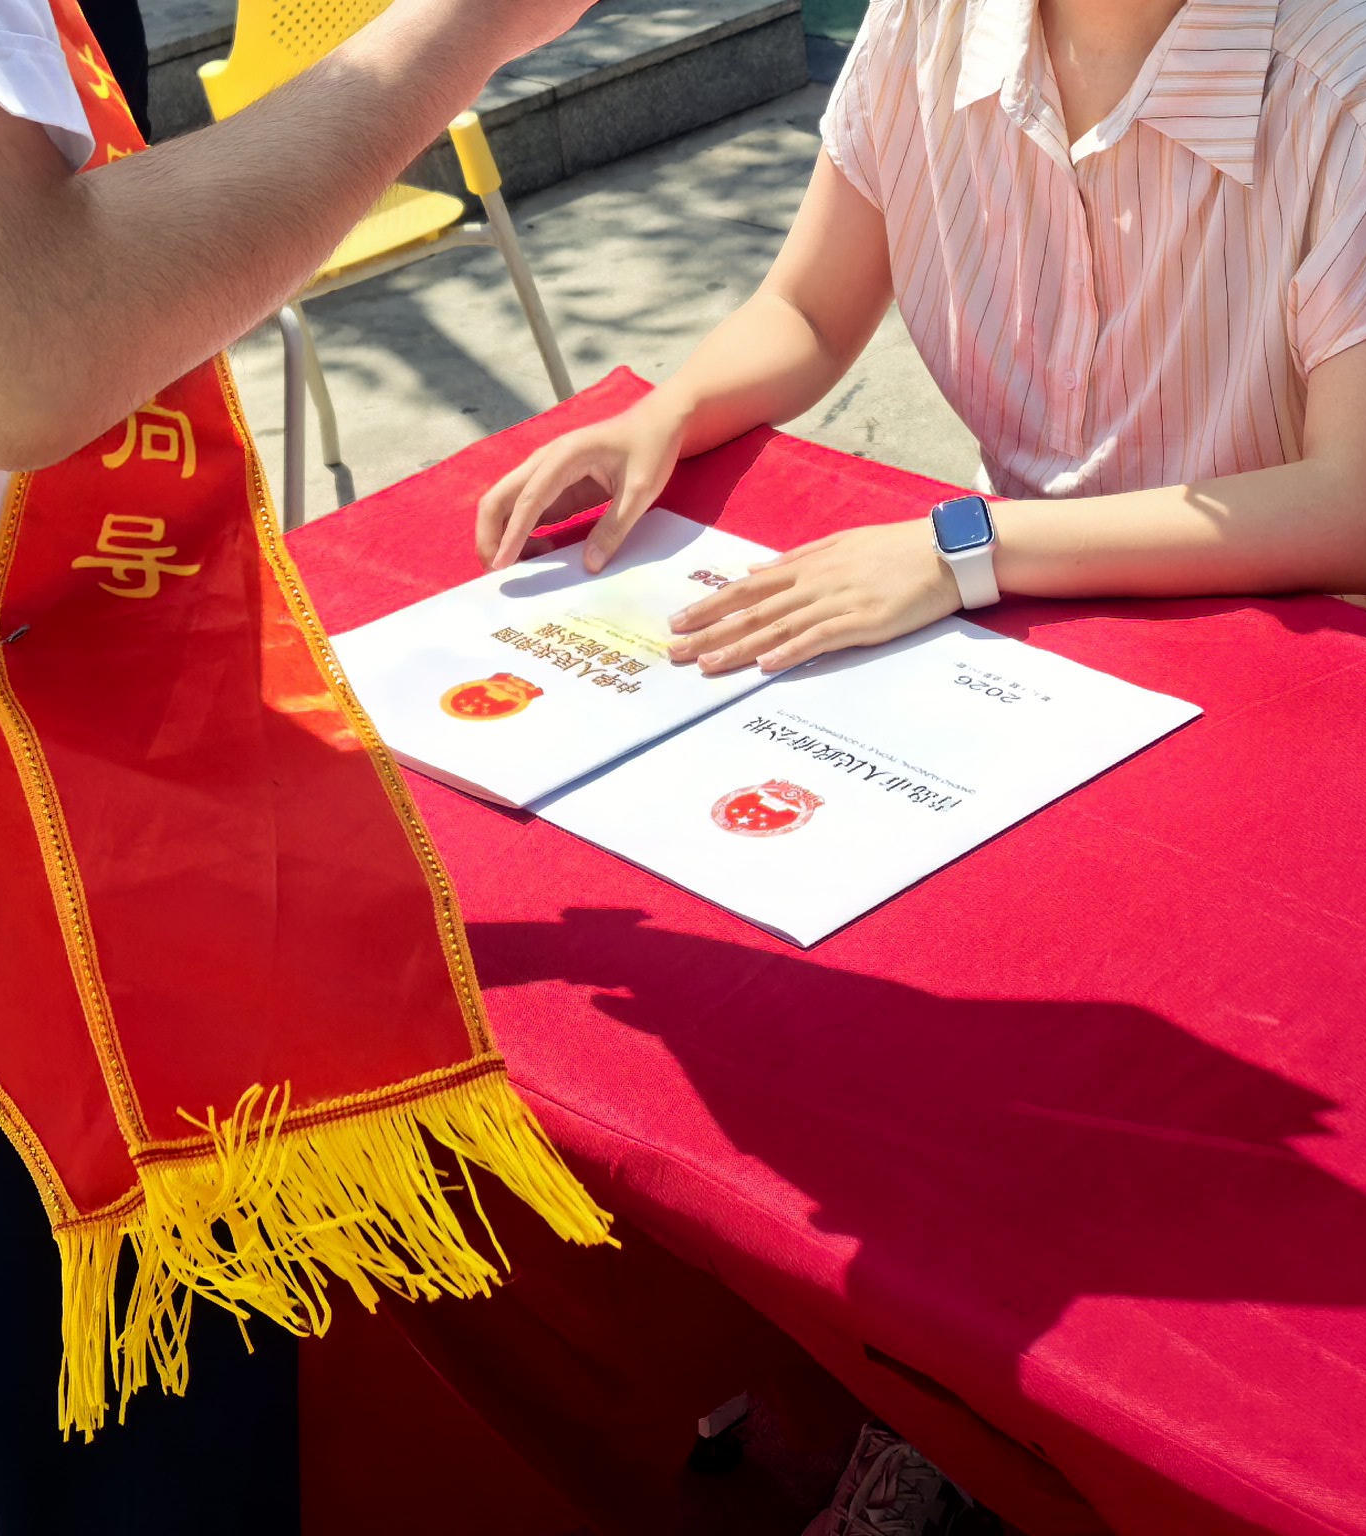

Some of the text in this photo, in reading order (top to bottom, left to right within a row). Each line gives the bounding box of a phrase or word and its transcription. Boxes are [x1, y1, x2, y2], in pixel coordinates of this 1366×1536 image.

[490, 626, 643, 695] 中华人民共和国
[533, 622, 651, 676] 国务院公报
[953, 674, 1022, 704] 2026
[742, 715, 963, 812] 青岛市人民政府公报
